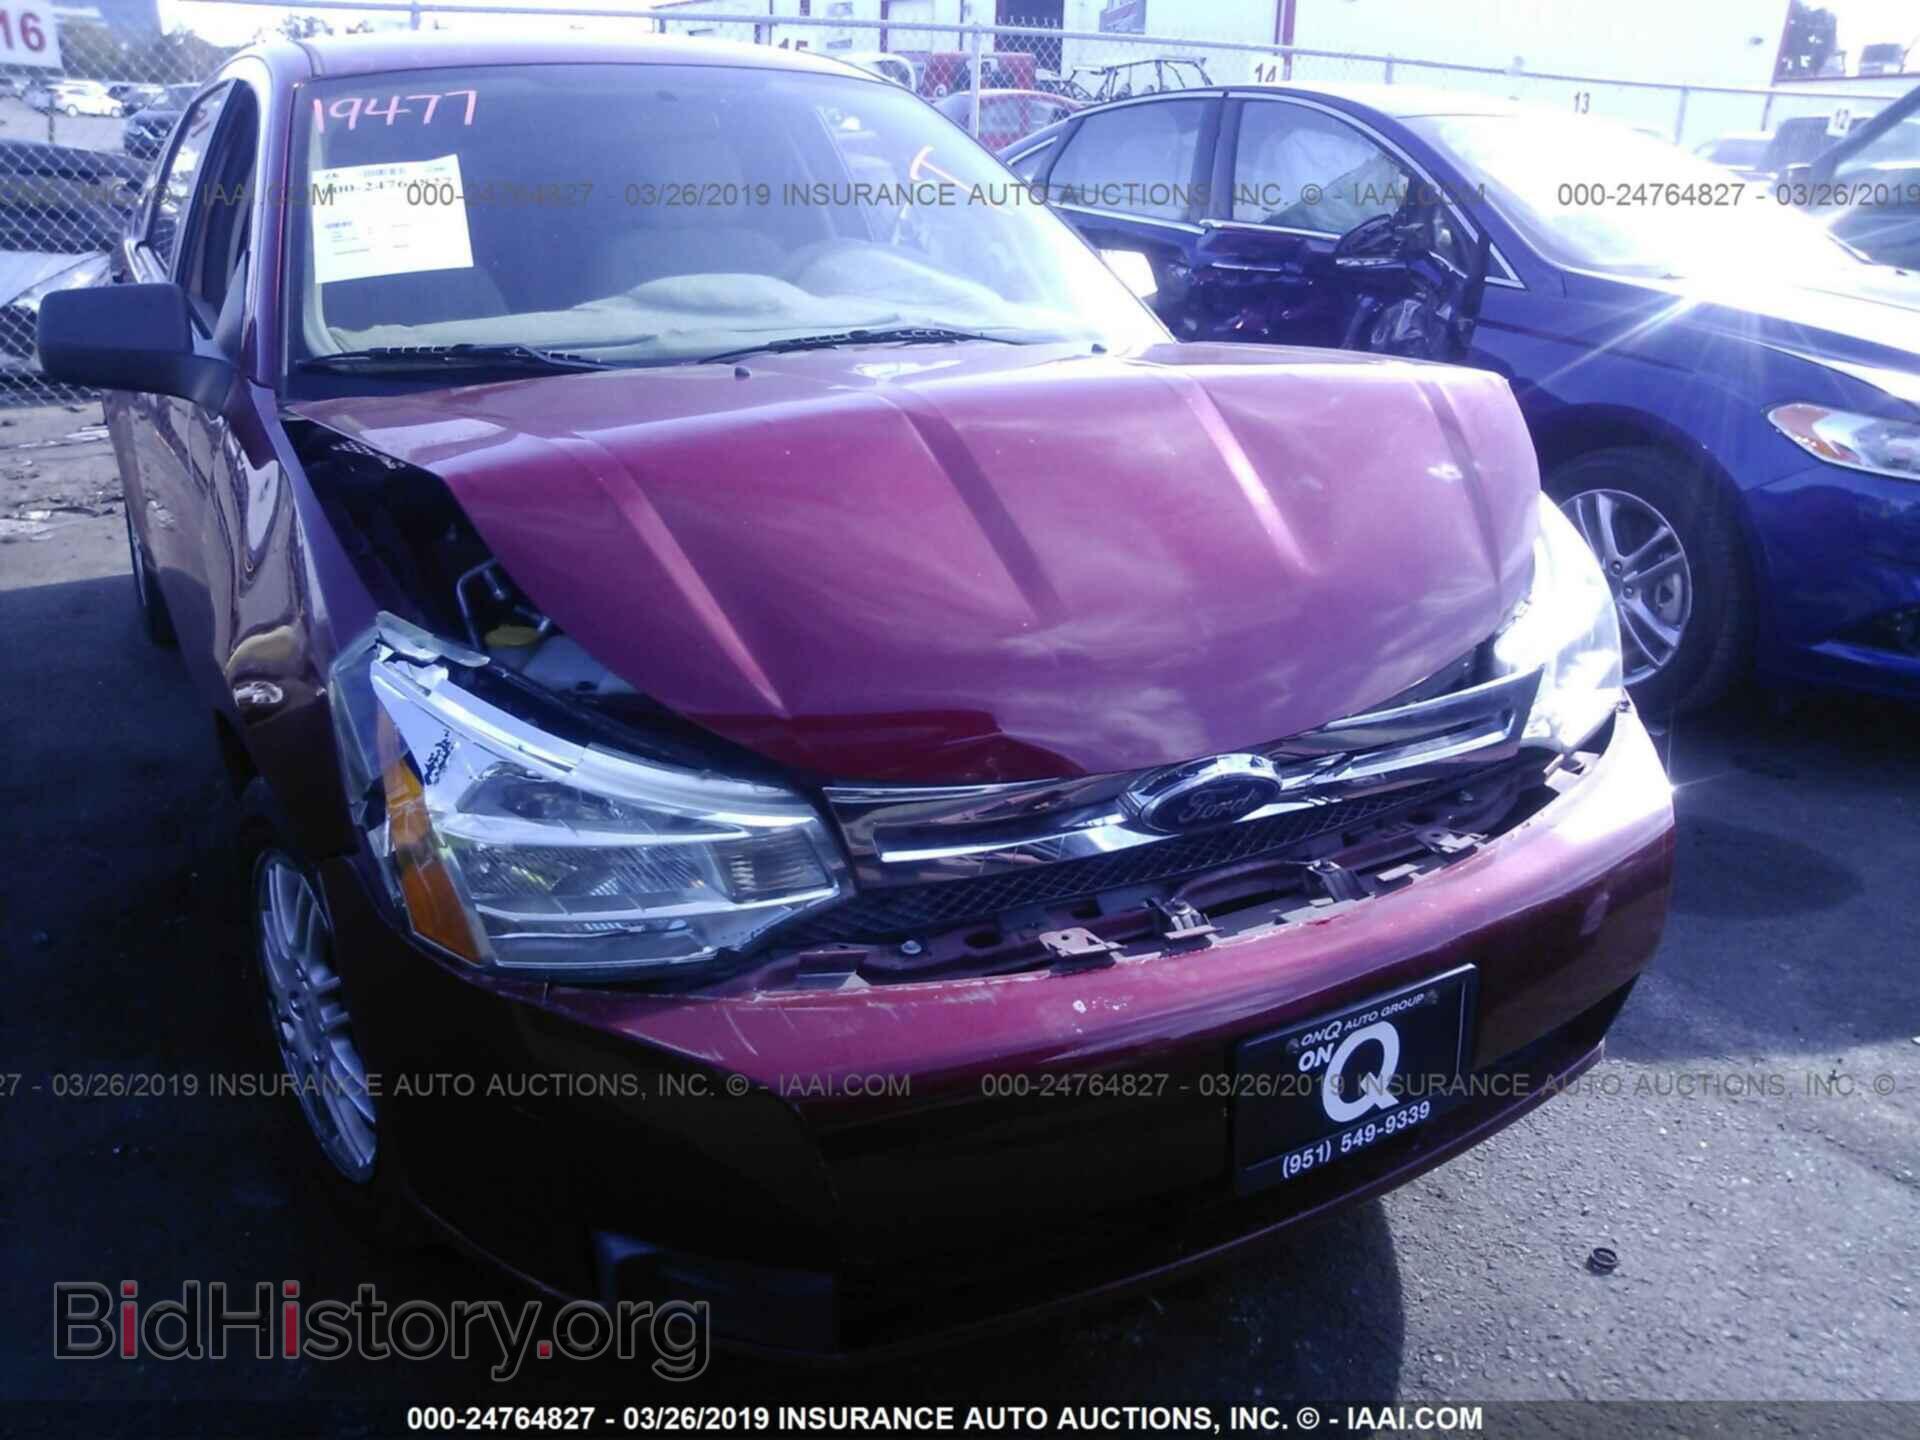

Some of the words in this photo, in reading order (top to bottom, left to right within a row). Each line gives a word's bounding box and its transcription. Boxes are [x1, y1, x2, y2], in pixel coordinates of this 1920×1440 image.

[0, 9, 46, 51] 16
[313, 90, 477, 133] 19477
[1573, 91, 1590, 114] 13
[1177, 783, 1257, 824] Ford
[1300, 1020, 1343, 1046] ONQ
[1343, 1010, 1378, 1032] AUTO
[1380, 992, 1425, 1018] GROUP
[1298, 1042, 1335, 1072] ON
[1321, 1020, 1400, 1123] Q
[1282, 1140, 1332, 1179] (951)
[1340, 1100, 1431, 1153] 549-9339
